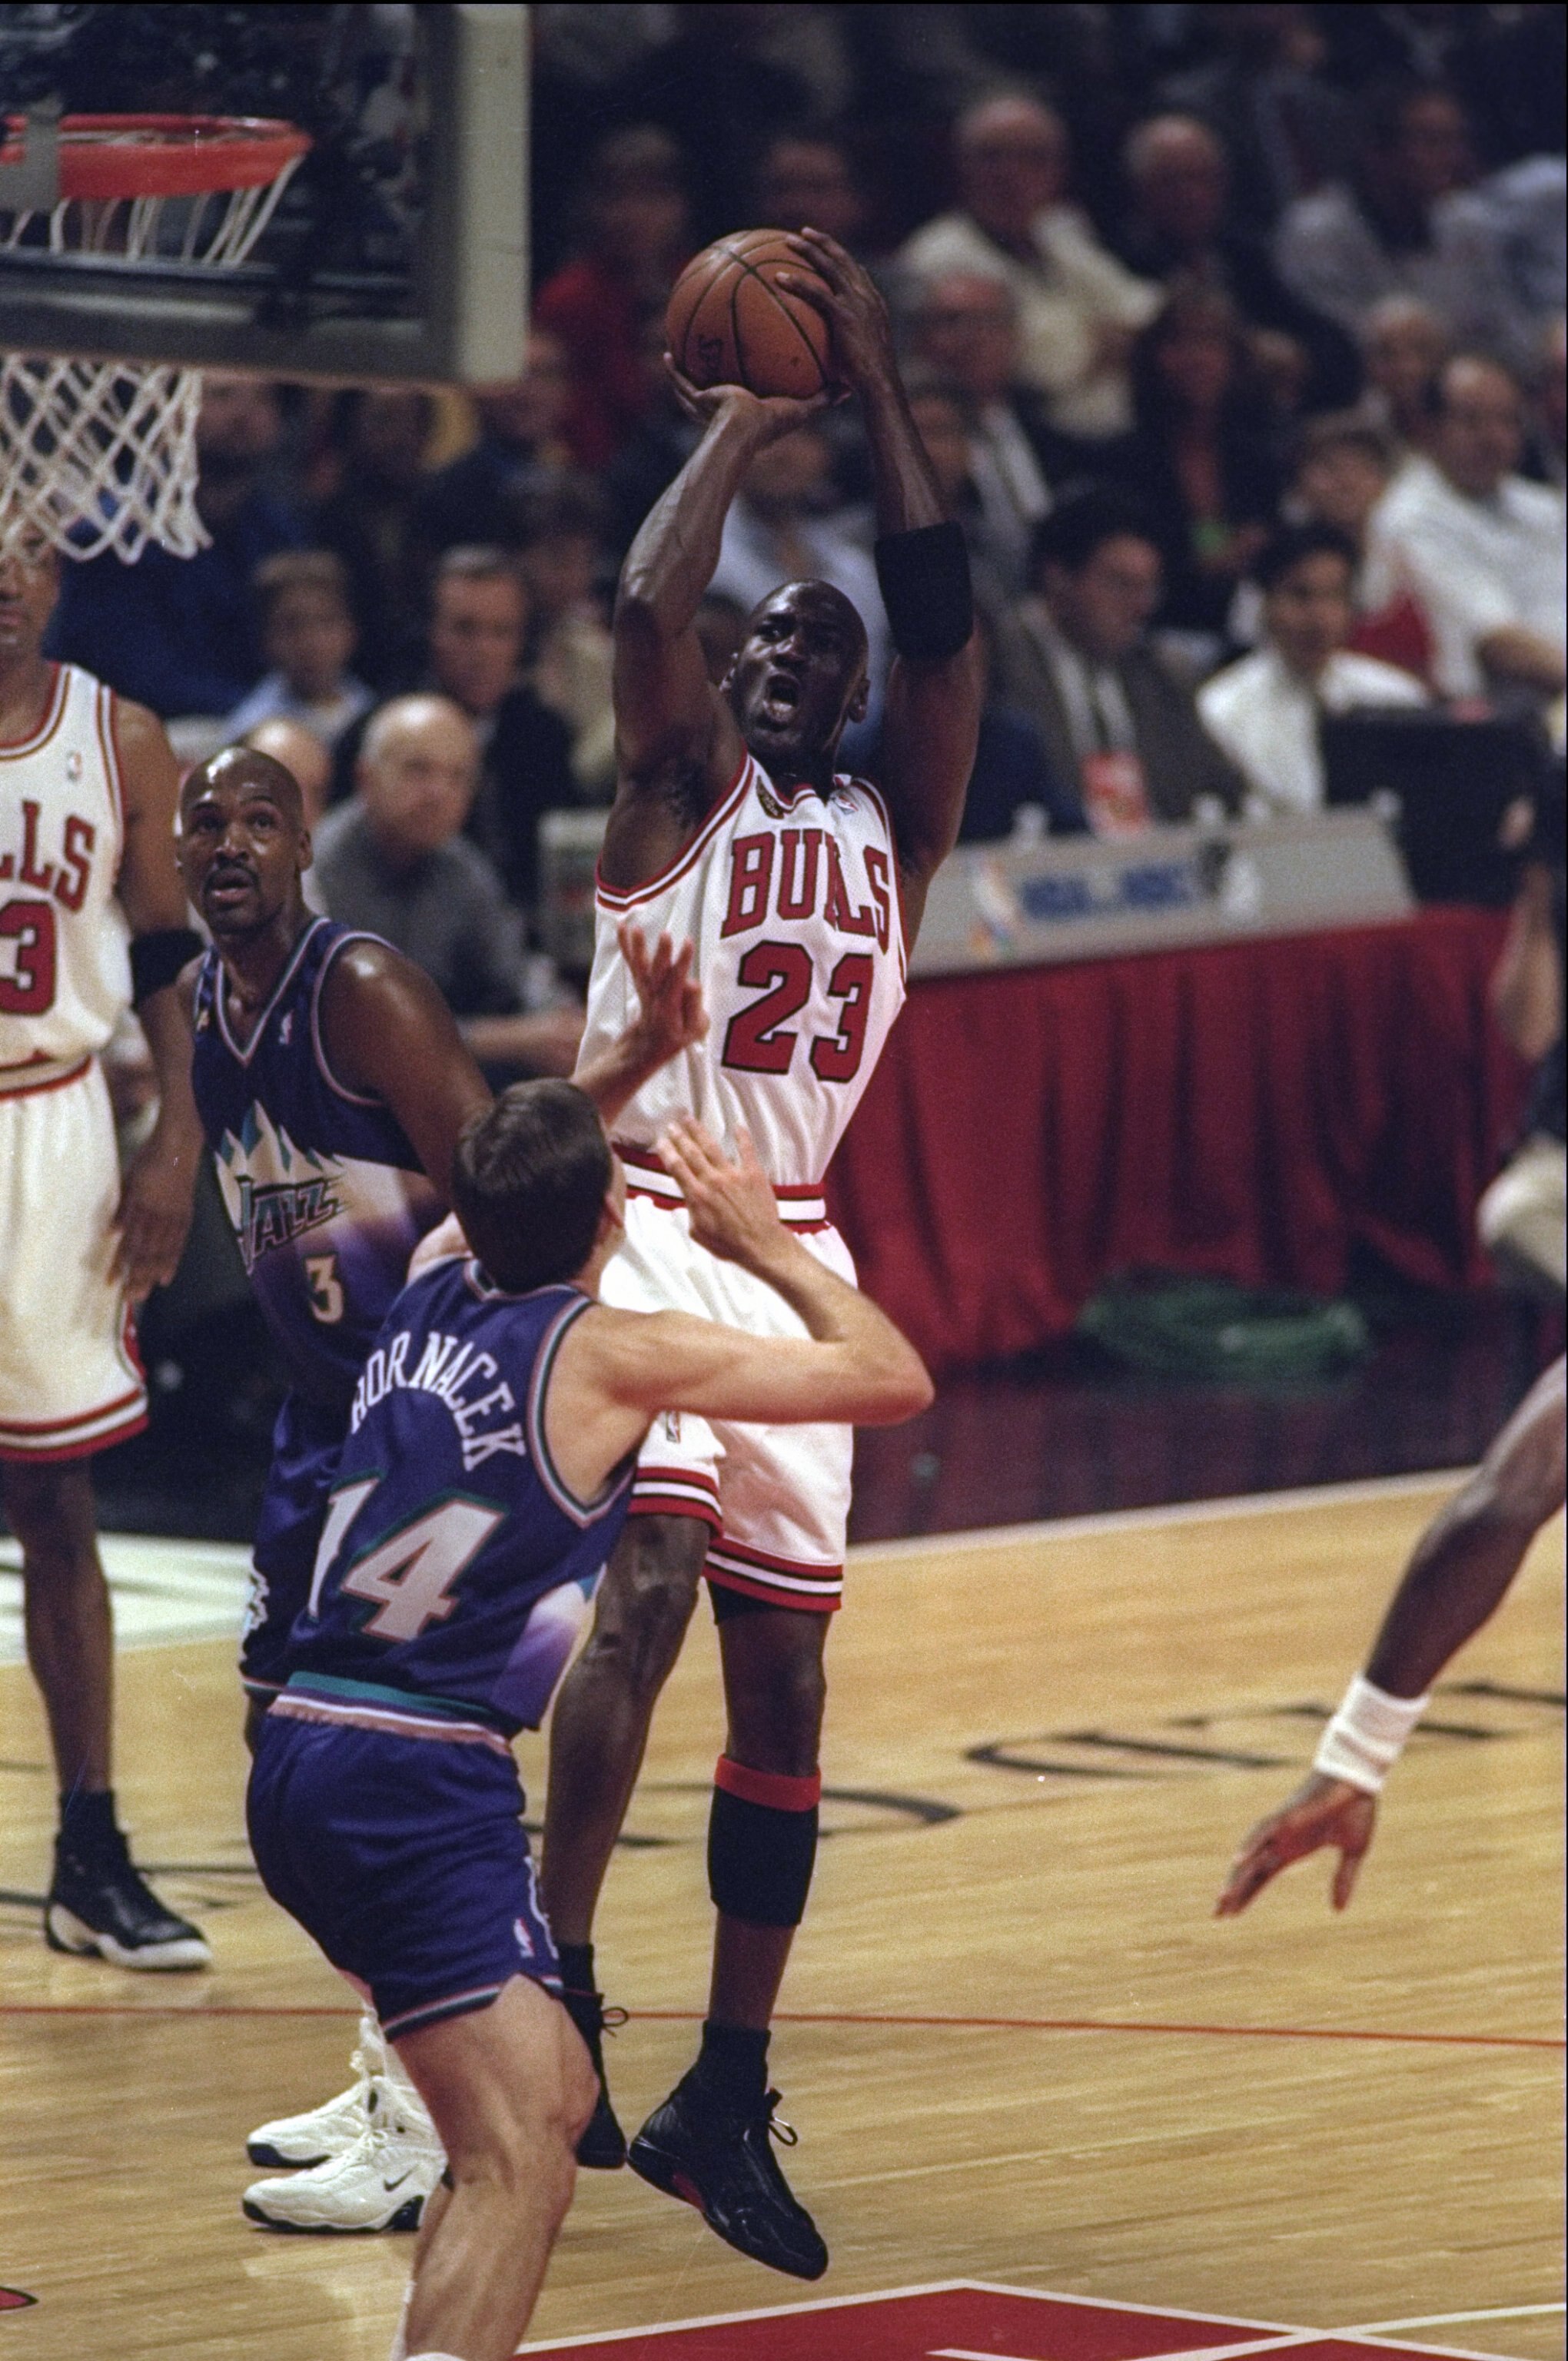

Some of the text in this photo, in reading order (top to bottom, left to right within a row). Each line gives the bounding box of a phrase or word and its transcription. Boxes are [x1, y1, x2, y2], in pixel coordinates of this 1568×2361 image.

[0, 798, 95, 912] LS
[721, 940, 874, 1084] 23
[234, 1175, 340, 1276] JAZZ
[304, 1252, 344, 1325] 3
[351, 1330, 527, 1472] HORNACEK
[307, 1473, 506, 1643] 14
